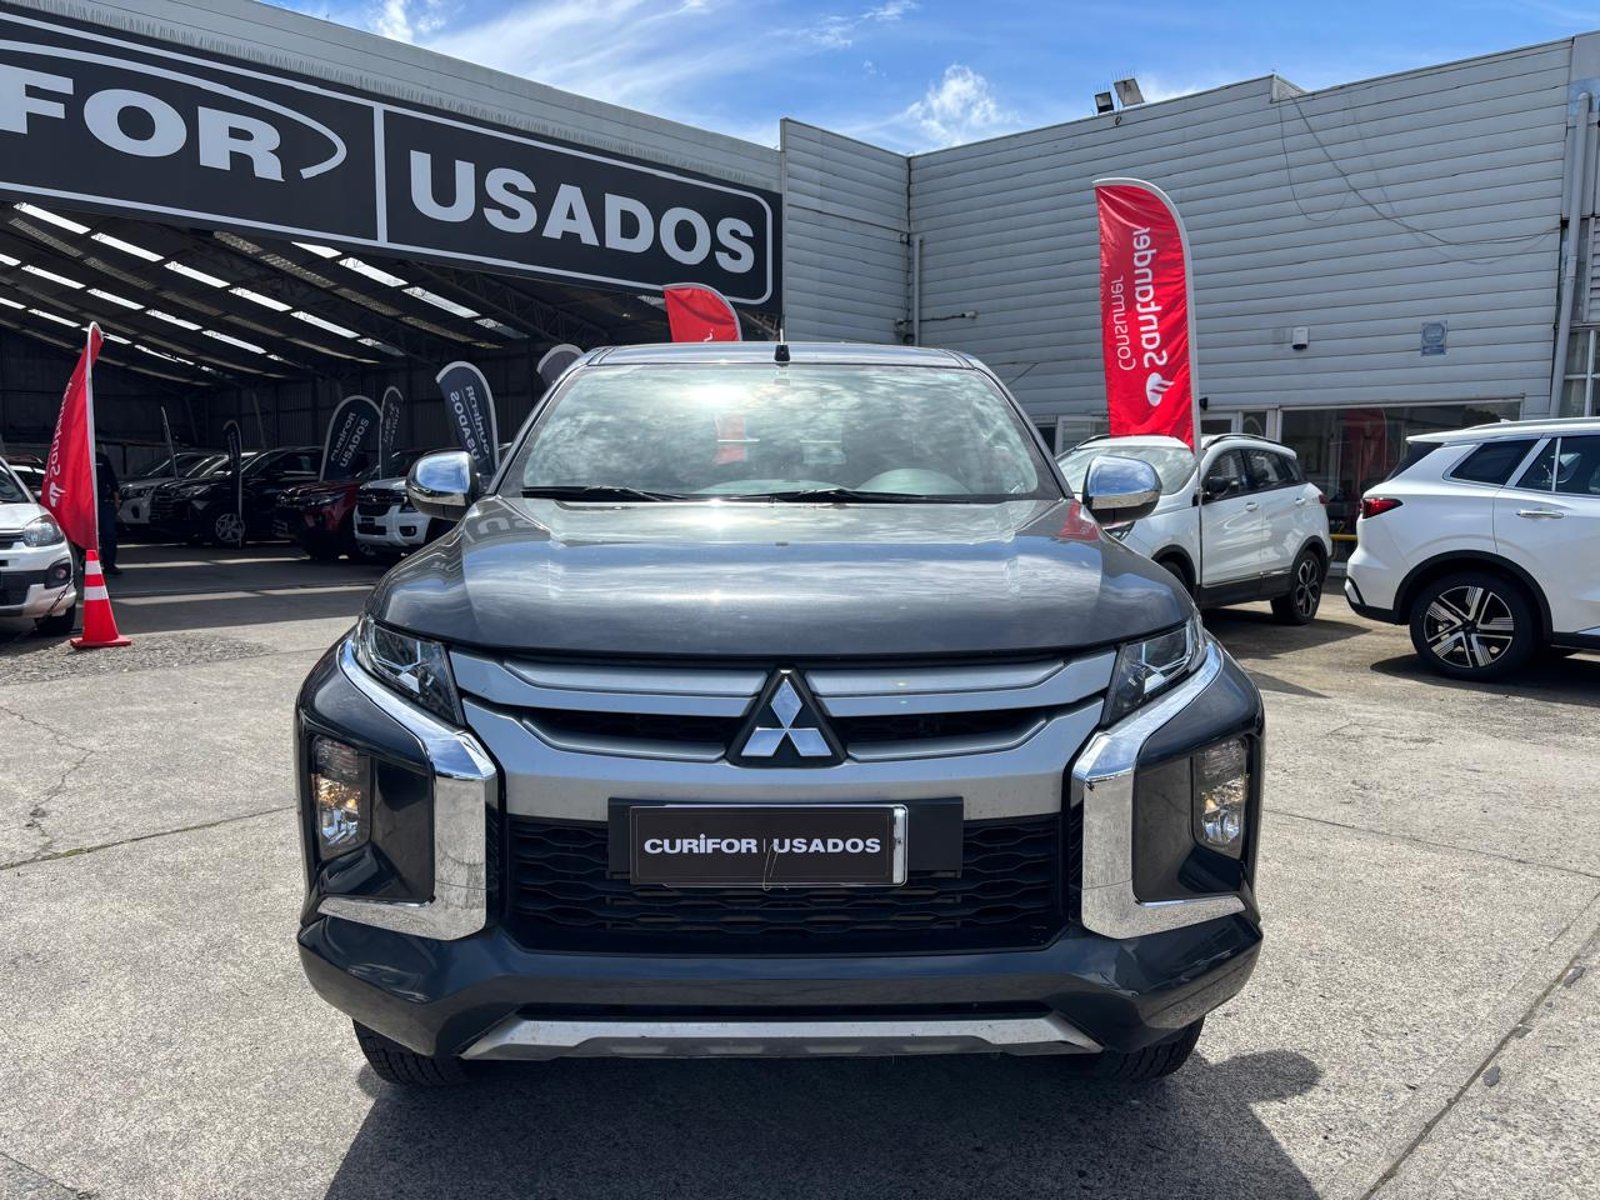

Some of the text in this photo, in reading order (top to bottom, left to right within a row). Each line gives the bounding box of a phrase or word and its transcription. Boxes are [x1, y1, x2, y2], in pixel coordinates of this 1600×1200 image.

[410, 150, 755, 274] USADOS
[340, 418, 369, 467] USADOS
[773, 837, 881, 854] USADOS
